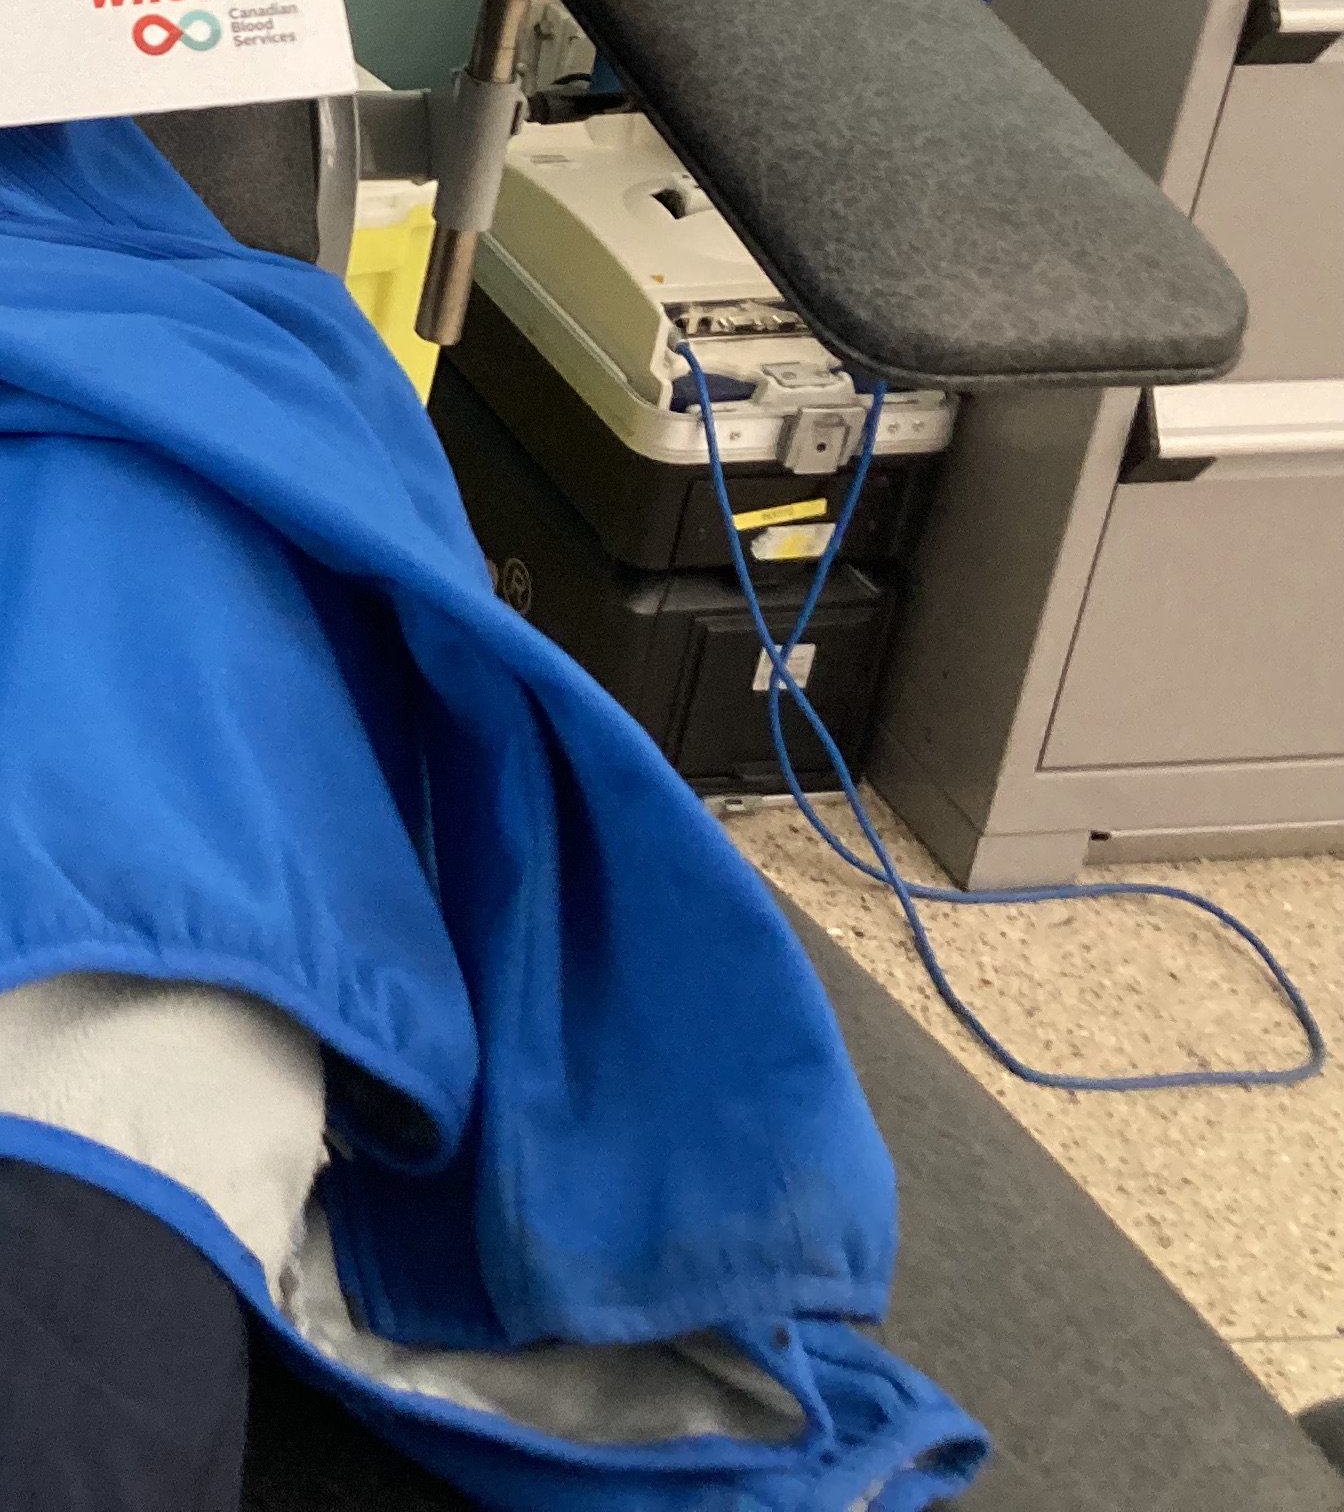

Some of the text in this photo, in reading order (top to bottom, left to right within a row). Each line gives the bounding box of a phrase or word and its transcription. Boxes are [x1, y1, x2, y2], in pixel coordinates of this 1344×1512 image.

[228, 3, 297, 20] Canadian
[231, 19, 275, 33] Blood
[234, 31, 297, 47] Services
